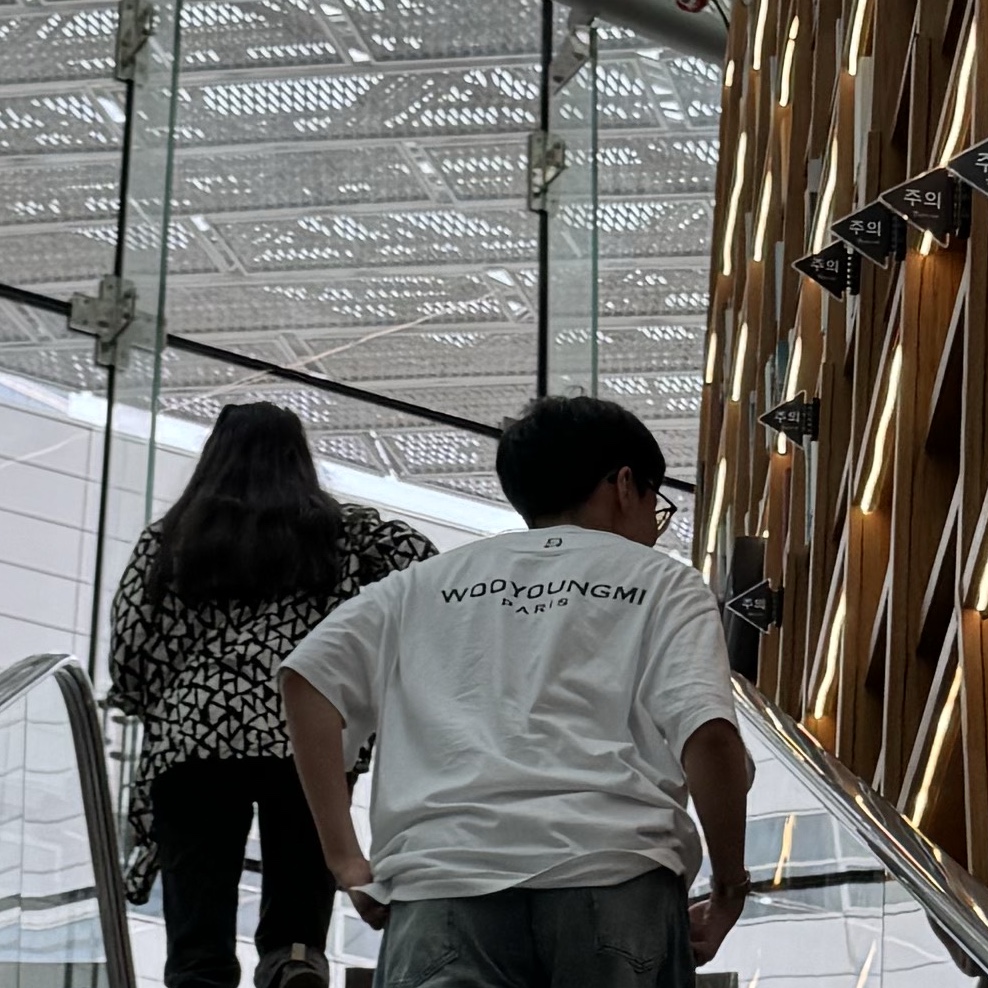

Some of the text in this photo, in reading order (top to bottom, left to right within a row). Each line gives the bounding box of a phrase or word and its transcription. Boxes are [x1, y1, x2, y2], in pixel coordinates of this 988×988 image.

[903, 188, 942, 210] 주의
[850, 219, 882, 237] 주의
[810, 257, 839, 273] 주의
[774, 410, 800, 424] 주의
[441, 578, 647, 606] WOOYOUNGMI
[501, 598, 569, 615] PARIS
